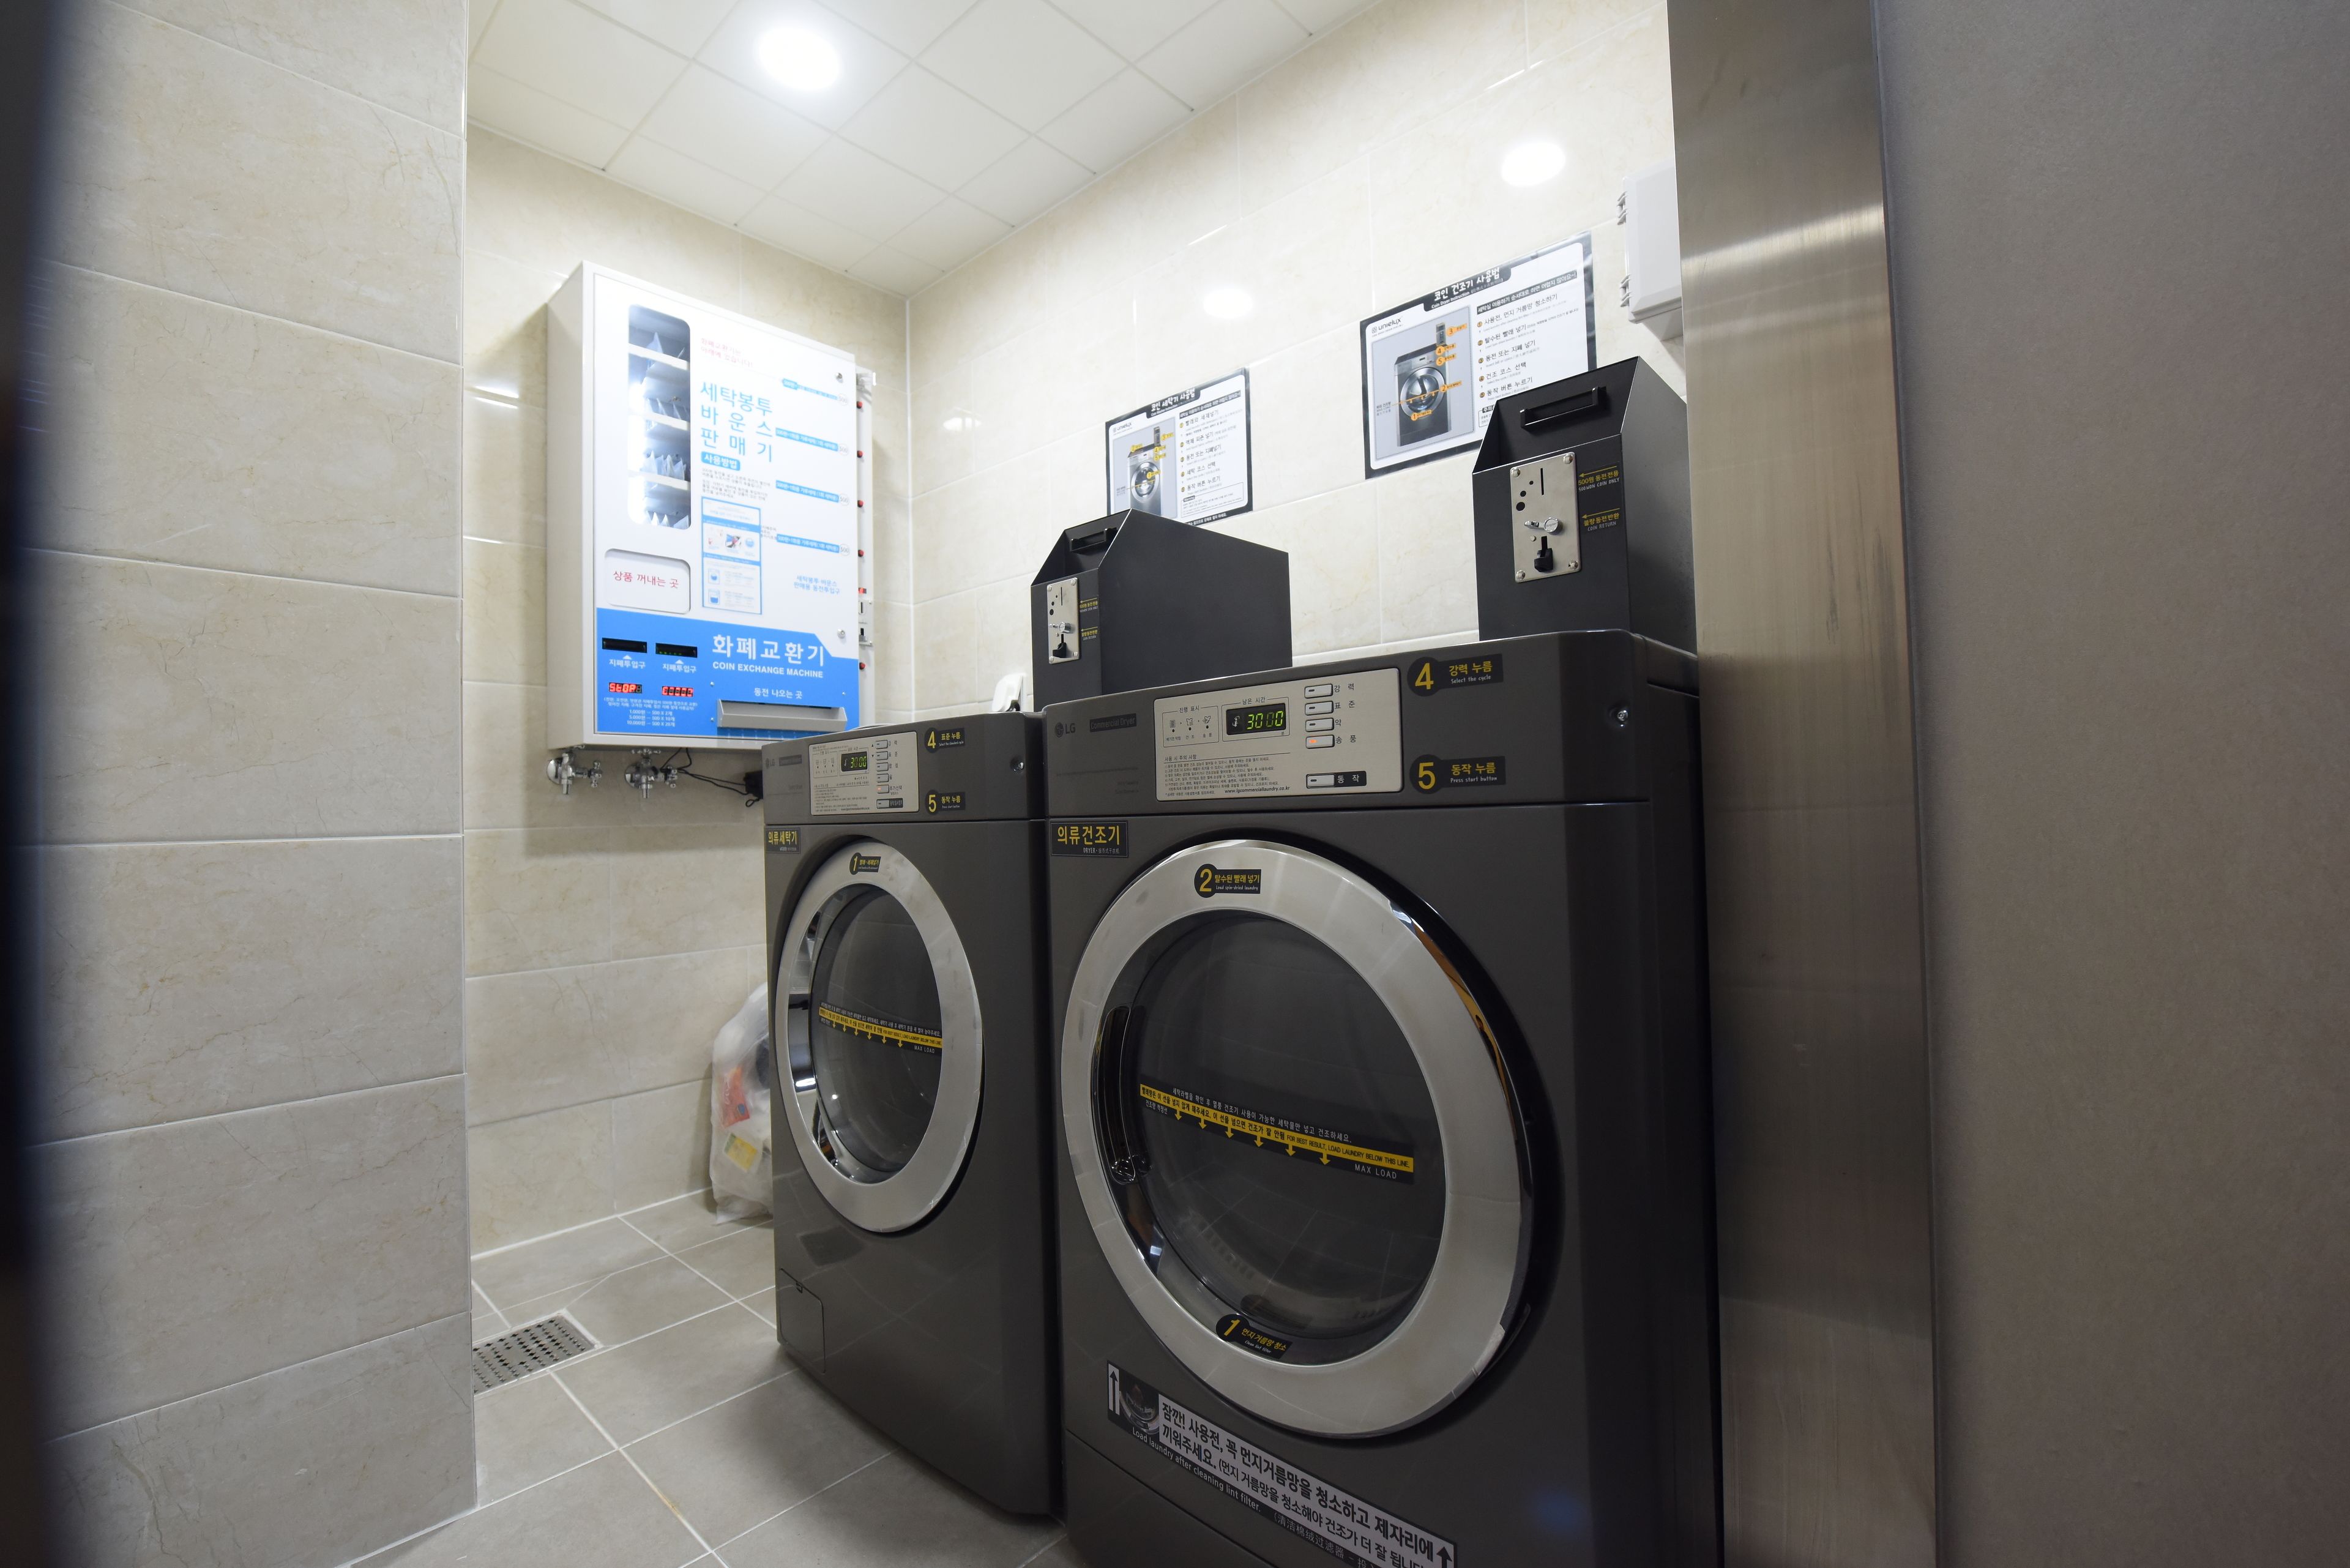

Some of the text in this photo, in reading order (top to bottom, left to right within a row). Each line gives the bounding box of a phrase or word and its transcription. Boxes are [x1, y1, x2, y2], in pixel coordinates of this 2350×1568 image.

[1434, 267, 1499, 301] 코인 건조기 사용법
[1504, 310, 1514, 318] 먼지
[1535, 294, 1557, 307] 청소하기
[1378, 317, 1401, 330] unielux
[1486, 353, 1496, 362] 동전
[1524, 340, 1535, 348] 넣기
[1515, 362, 1526, 370] 선택
[1487, 387, 1498, 396] 동작
[1515, 377, 1532, 387] 누르기
[701, 381, 772, 417] 세탁봉투
[1162, 396, 1178, 407] 세탁기
[704, 454, 738, 469] 사용방법
[1578, 476, 1594, 485] 500원
[613, 570, 679, 589] 상품 꺼내는 곳
[712, 634, 824, 666] 화폐교환기
[609, 659, 646, 669] 지폐투입구
[663, 663, 696, 673] 지폐투입구
[712, 662, 823, 678] COIN EXCHANGE MACHINE
[1449, 660, 1493, 676] 강력 누름
[1415, 662, 1434, 690] 4
[754, 687, 802, 700] 동전 나오는 곳
[1065, 717, 1135, 734] LG Commercial Dryer
[928, 731, 936, 749] 4
[1419, 762, 1436, 790] 5
[1451, 762, 1496, 776] 동작 누름
[929, 794, 936, 813] 5
[768, 831, 797, 845] 의류세탁기
[1058, 825, 1119, 845] 의류건조기
[854, 856, 857, 872] 1
[1199, 868, 1212, 892] 2
[1215, 875, 1259, 883] 탈수된 빨래 넣기
[1145, 1100, 1168, 1115] 건조량 적정선
[1172, 1098, 1180, 1107] 넘지
[1181, 1102, 1190, 1111] 않게
[1220, 1114, 1229, 1124] 선을
[1231, 1118, 1246, 1129] 넘으면
[1248, 1122, 1263, 1134] 건조가
[1274, 1130, 1285, 1140] 안됨
[1342, 1148, 1364, 1159] LAUNDRY
[1366, 1153, 1383, 1162] BELOW
[1384, 1157, 1396, 1165] THIS
[1225, 1103, 1239, 1114] 건조기
[1241, 1108, 1256, 1119] 사용이
[1259, 1113, 1275, 1125] 가능한
[1278, 1118, 1300, 1132] 세탁물만
[1304, 1124, 1315, 1135] 넣고
[1318, 1128, 1352, 1143] 건조하세요.
[1355, 1163, 1397, 1179] MAX LOAD
[1224, 1319, 1241, 1336] 1
[1274, 1342, 1286, 1351] 청소
[1132, 1427, 1261, 1512] Load laundry after cleaning lint filter.
[1162, 1402, 1433, 1562] 잠깐! 사용전, 꼭 먼지거름망을 청소하고 제자리에
[1163, 1424, 1217, 1469] 끼워주세요.
[1219, 1458, 1239, 1482] (먼지
[1241, 1471, 1278, 1504] 거름망을
[1281, 1493, 1323, 1528] 청소해야
[1326, 1517, 1359, 1546] 건조가
[1360, 1536, 1371, 1554] 더
[1375, 1542, 1387, 1562] 잘
